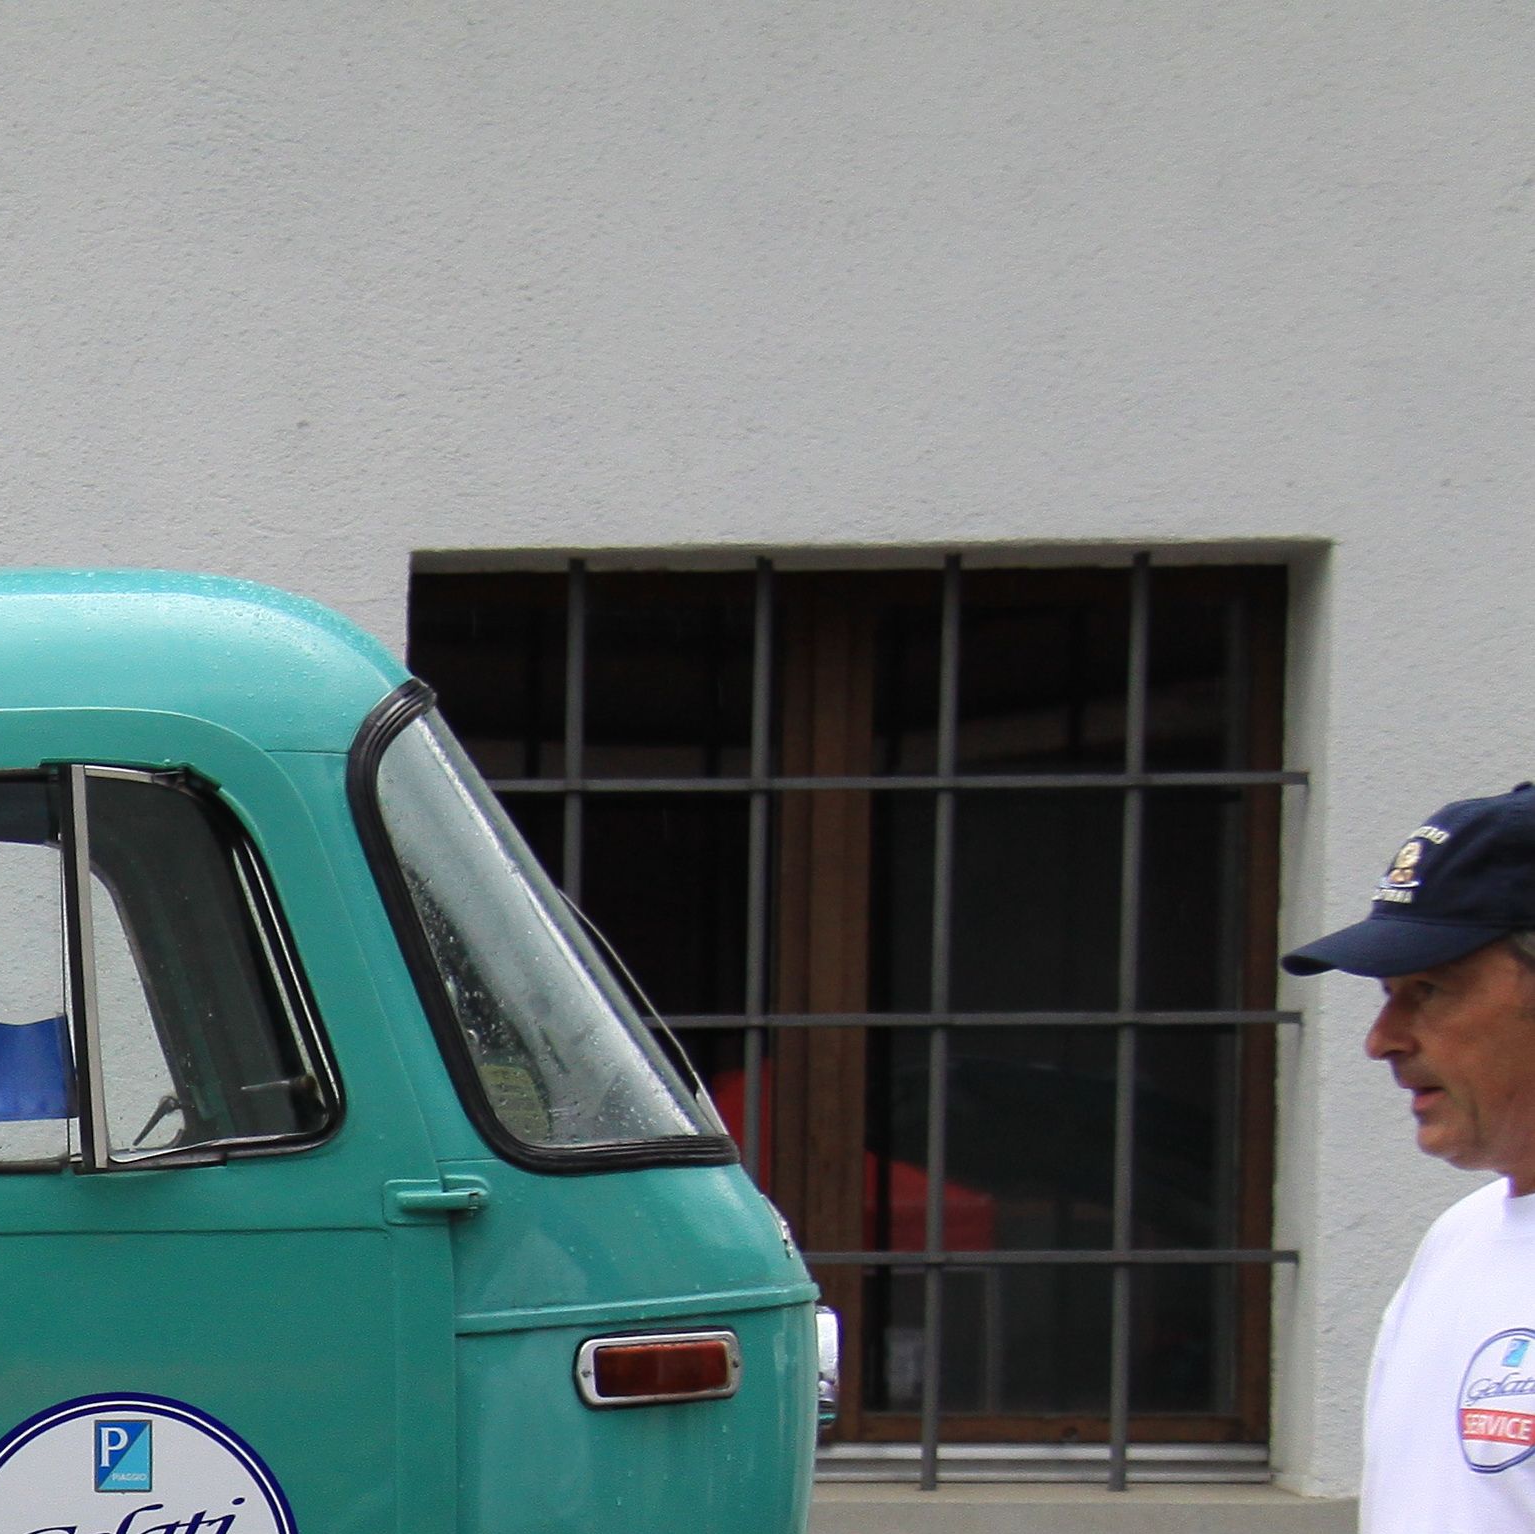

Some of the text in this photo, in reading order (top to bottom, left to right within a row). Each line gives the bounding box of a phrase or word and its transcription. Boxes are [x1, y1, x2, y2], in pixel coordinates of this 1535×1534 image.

[1464, 1372, 1535, 1407] Gelat
[1463, 1413, 1533, 1441] SERVICE
[100, 1427, 129, 1468] P
